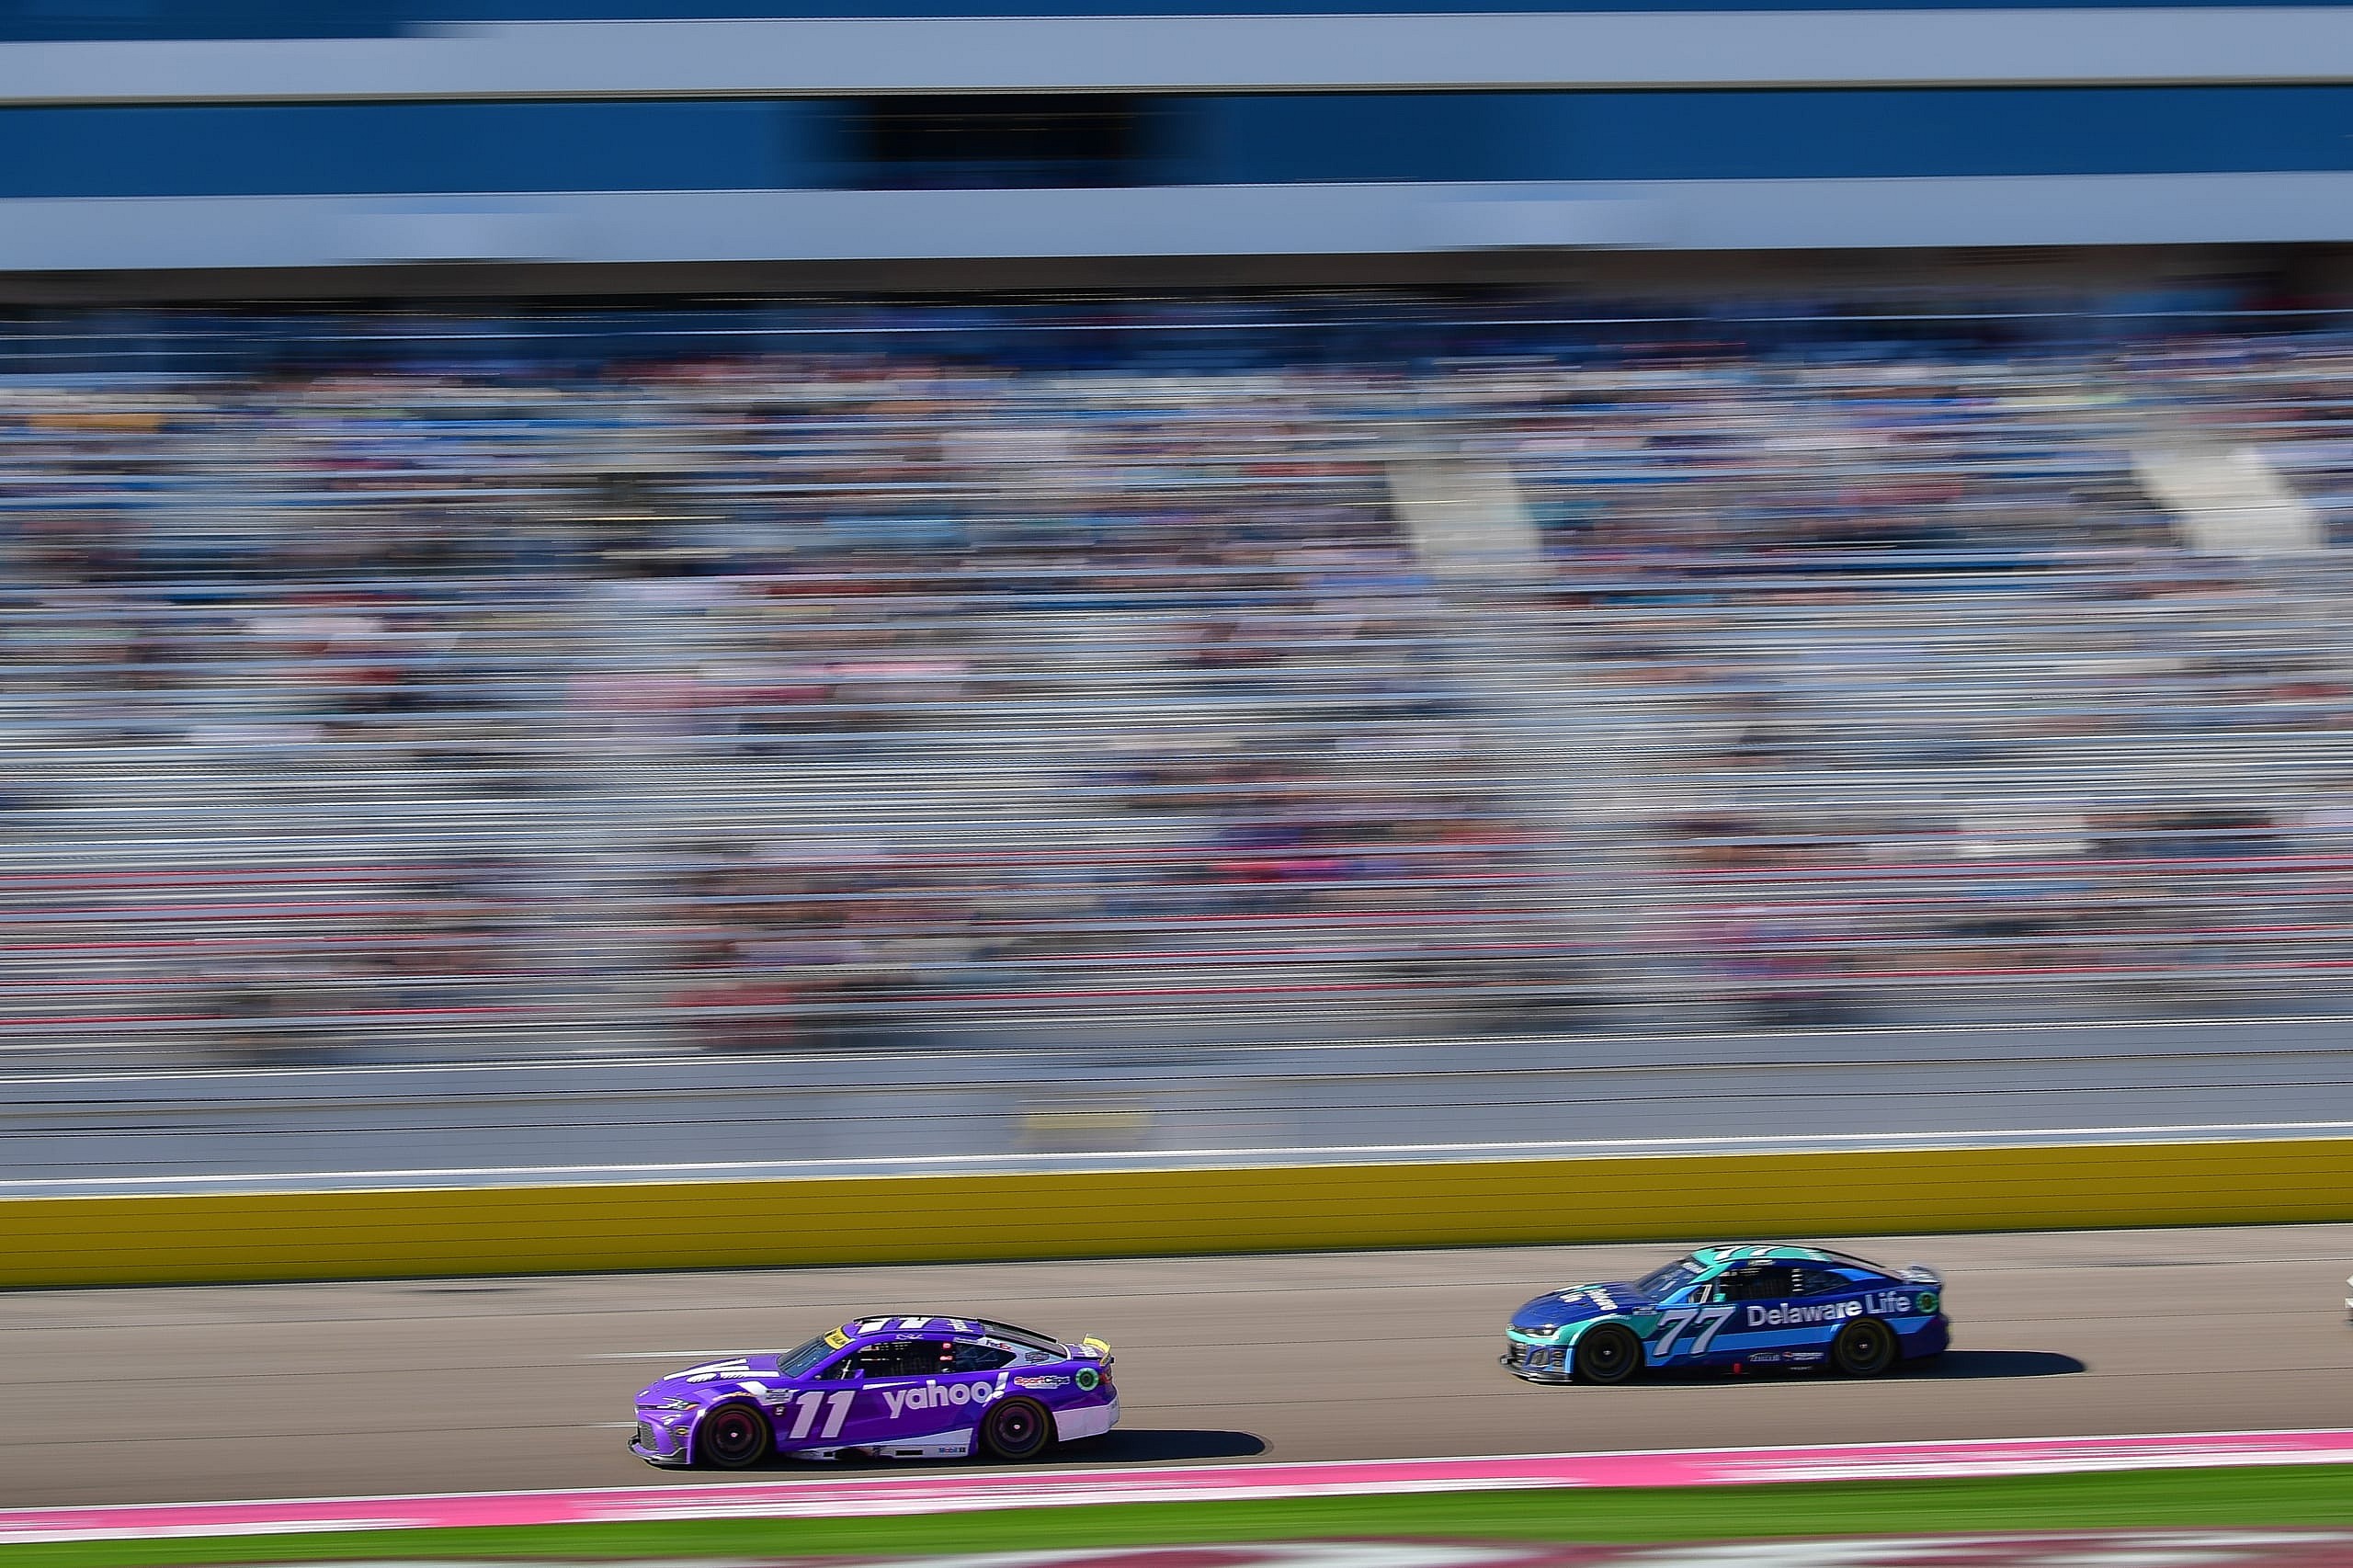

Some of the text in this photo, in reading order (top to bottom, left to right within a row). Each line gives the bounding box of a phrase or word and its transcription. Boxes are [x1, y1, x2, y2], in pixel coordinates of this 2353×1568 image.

[1653, 1305, 1736, 1356] 77
[1746, 1290, 1911, 1326] Delaware Life
[789, 1391, 856, 1438] 11
